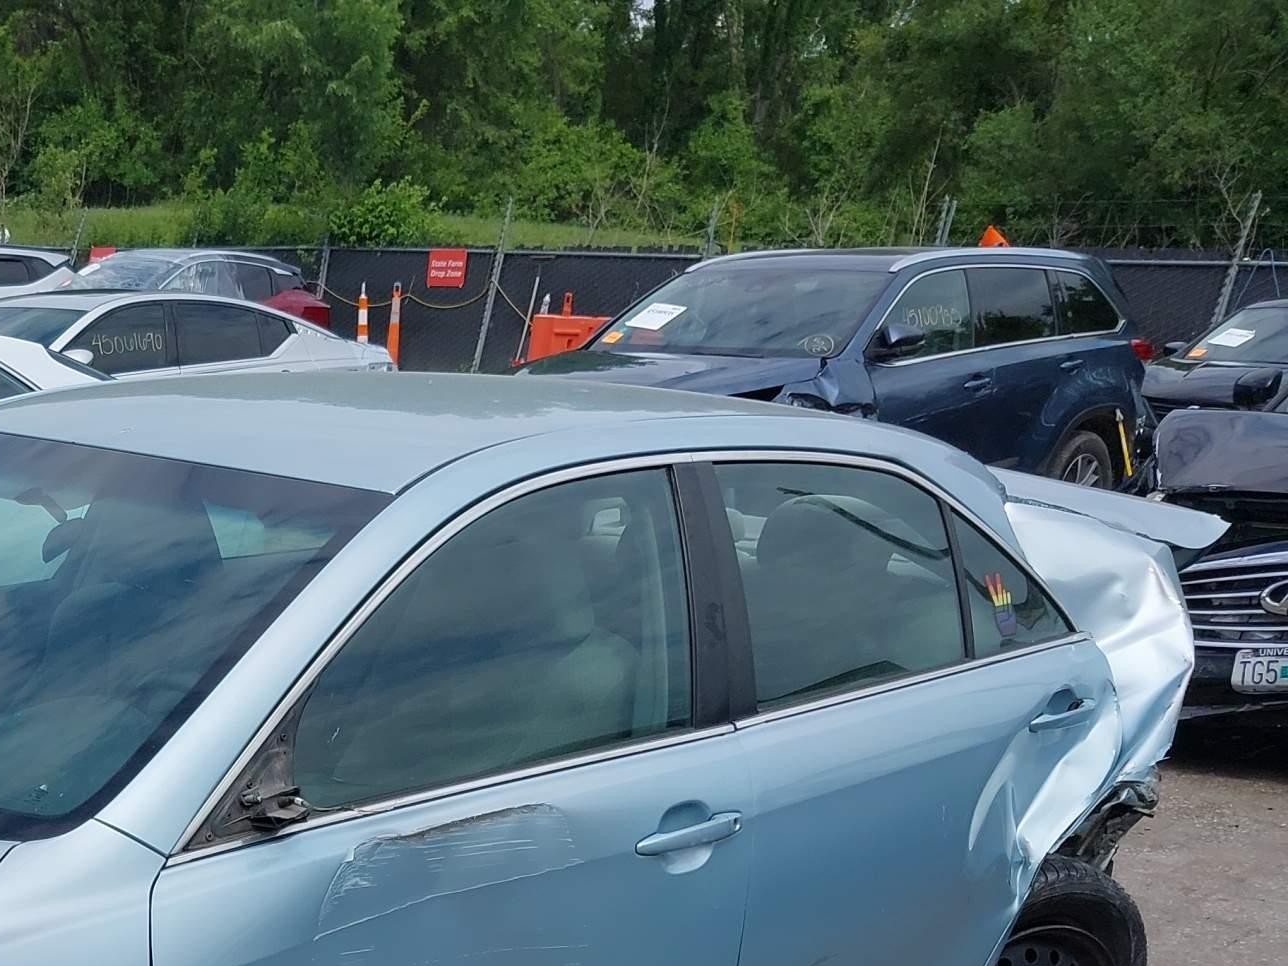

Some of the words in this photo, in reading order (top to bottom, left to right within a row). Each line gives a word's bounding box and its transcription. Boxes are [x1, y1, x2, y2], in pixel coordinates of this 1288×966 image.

[431, 260, 447, 268] State
[448, 260, 463, 268] Farm
[430, 270, 445, 278] Drop
[446, 270, 462, 278] Zone
